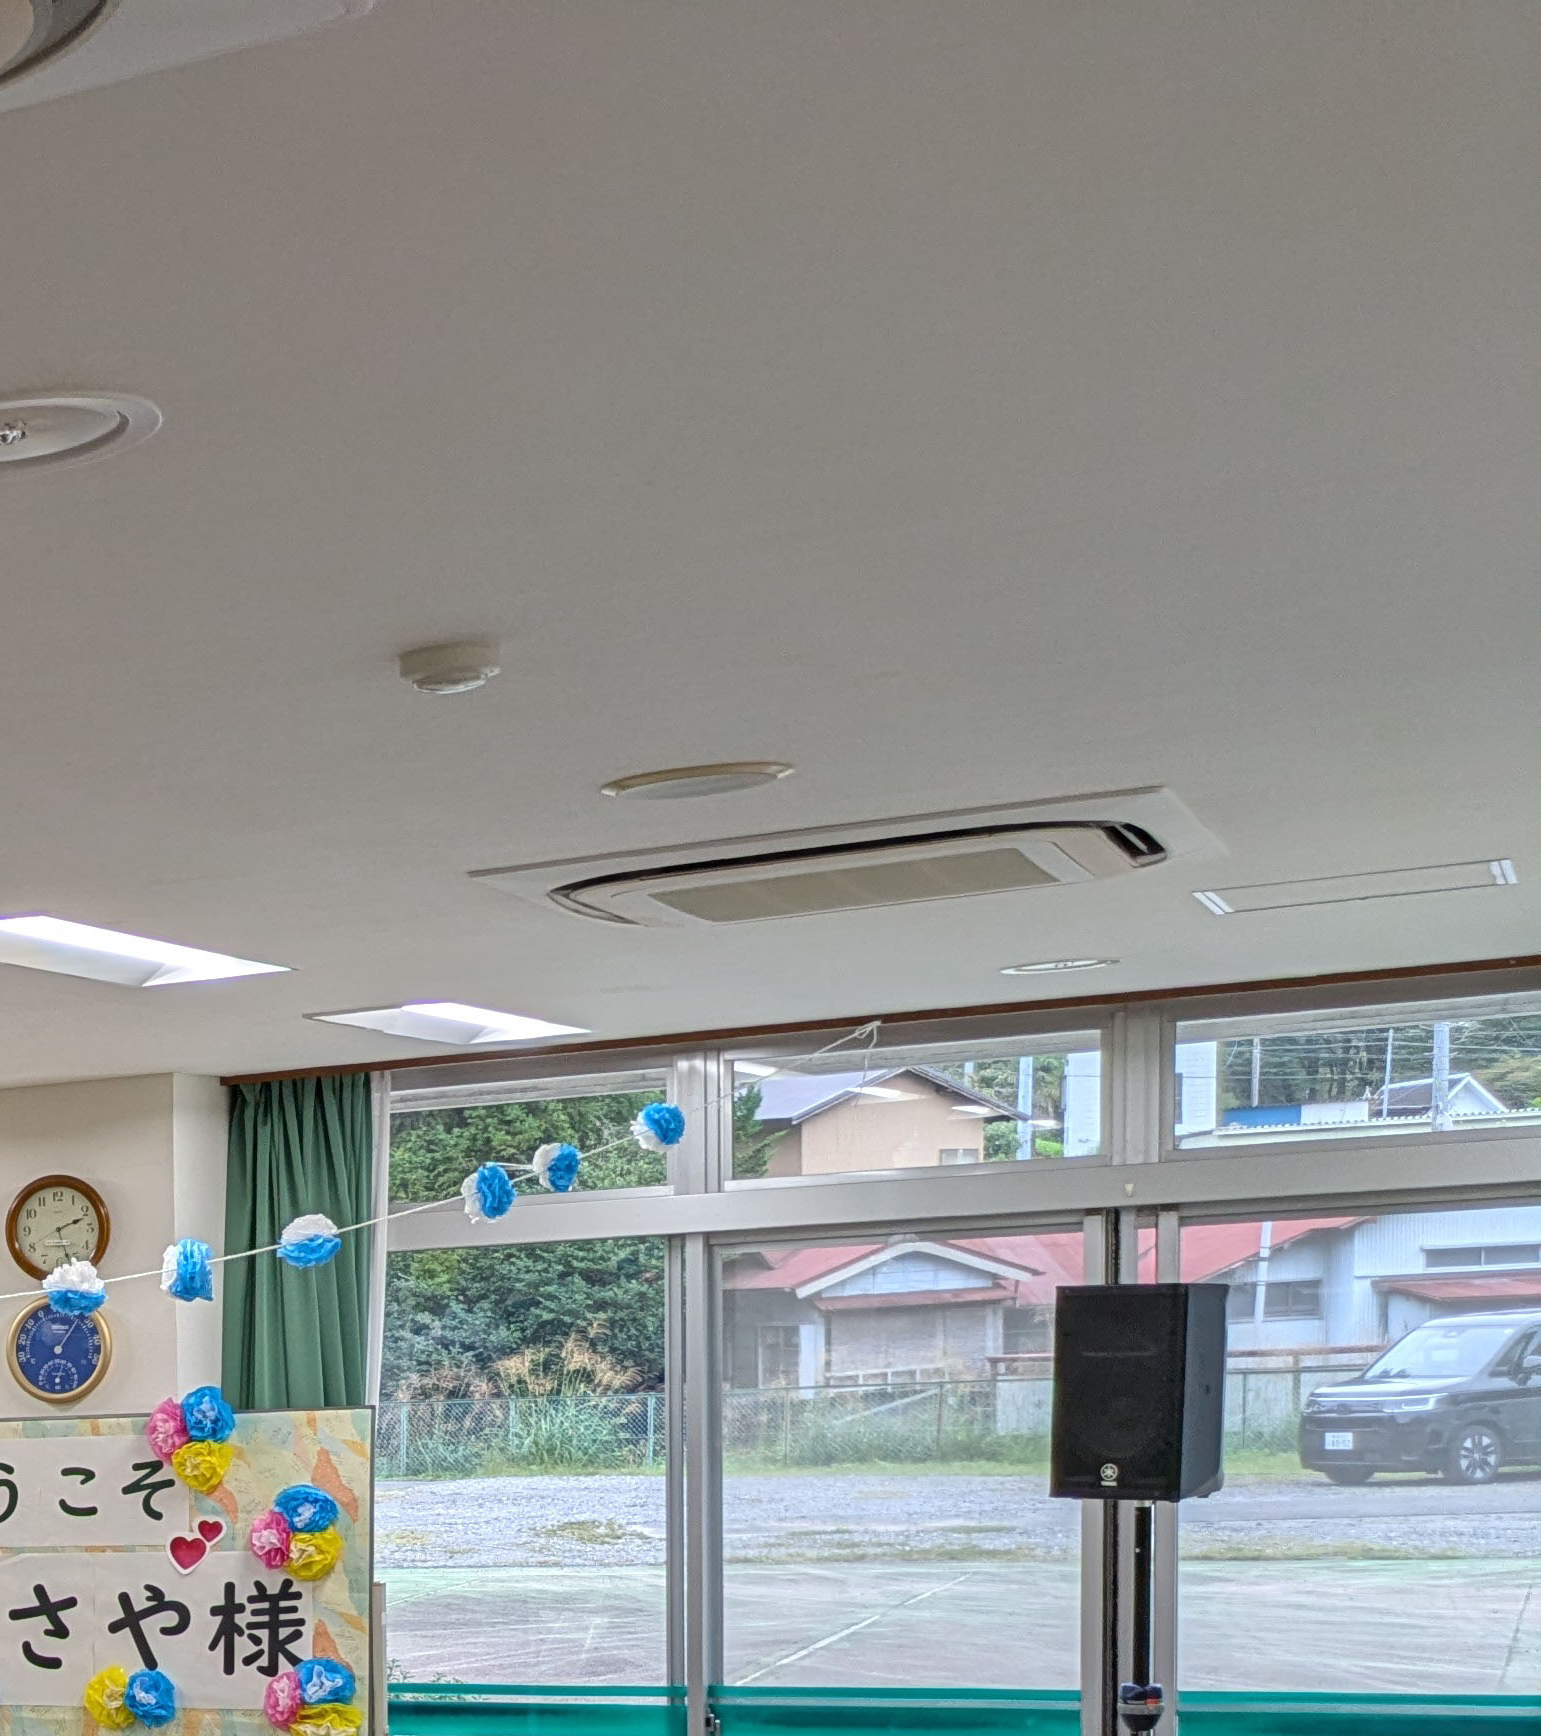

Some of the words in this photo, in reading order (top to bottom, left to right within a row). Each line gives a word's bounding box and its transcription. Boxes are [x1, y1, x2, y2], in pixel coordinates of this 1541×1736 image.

[39, 1196, 45, 1207] 11
[53, 1191, 63, 1201] 12
[26, 1208, 36, 1219] 10
[81, 1205, 89, 1216] 2
[23, 1225, 31, 1236] 9
[28, 1243, 36, 1253] 8
